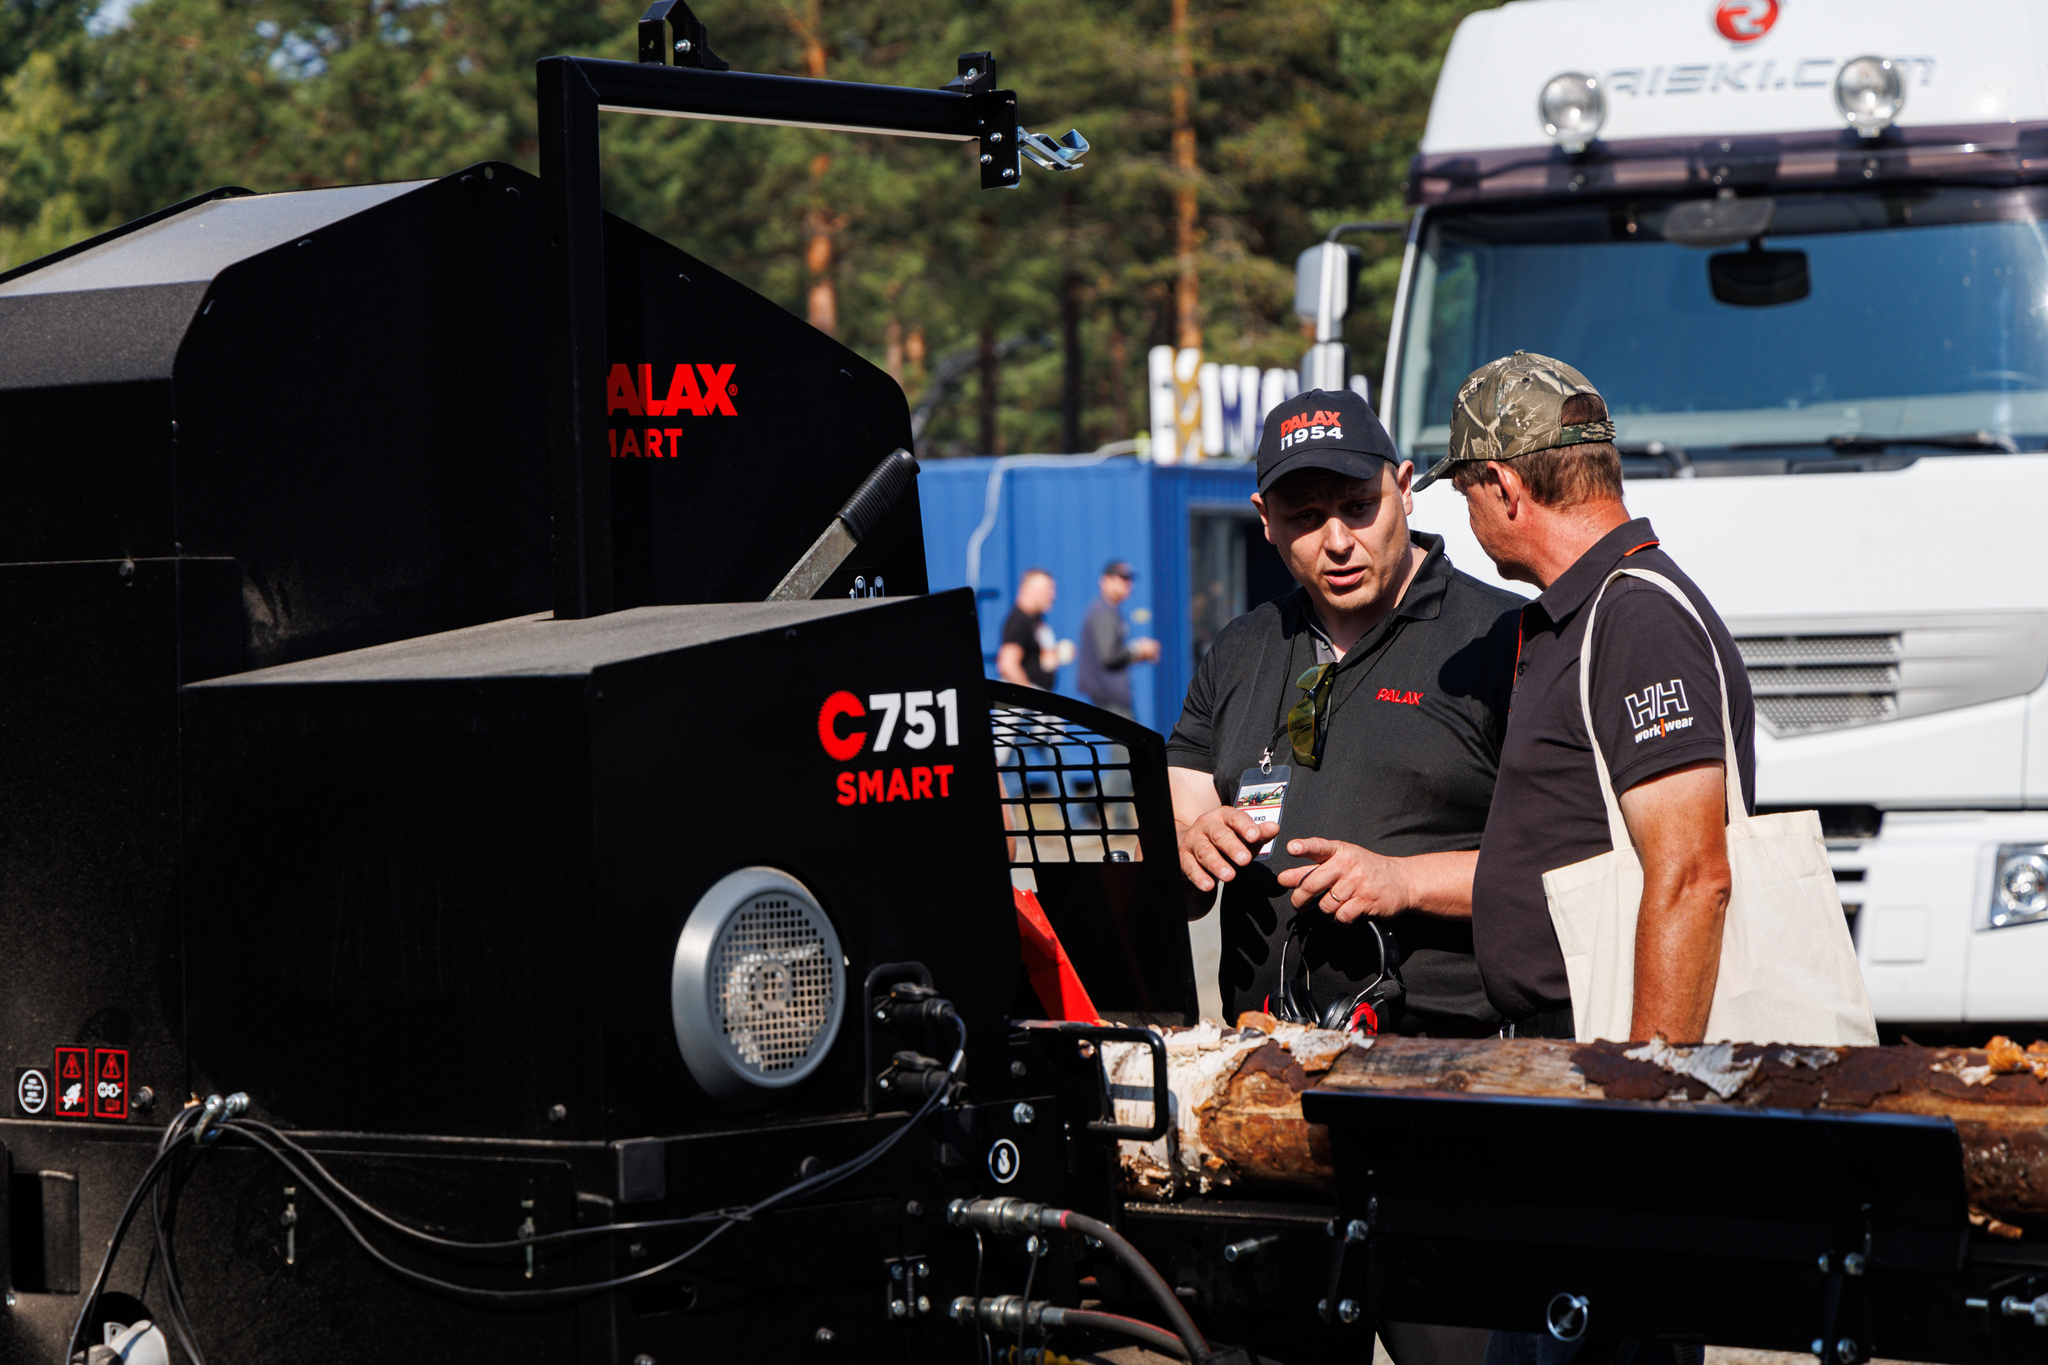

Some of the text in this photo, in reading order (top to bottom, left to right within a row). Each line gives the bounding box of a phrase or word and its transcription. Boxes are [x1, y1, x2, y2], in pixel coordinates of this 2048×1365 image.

[1280, 410, 1342, 438] PALAX
[1285, 425, 1344, 448] 1954
[608, 428, 683, 458] ART
[1375, 687, 1425, 706] PALAX
[1624, 679, 1690, 730] HH
[836, 764, 955, 807] SMART
